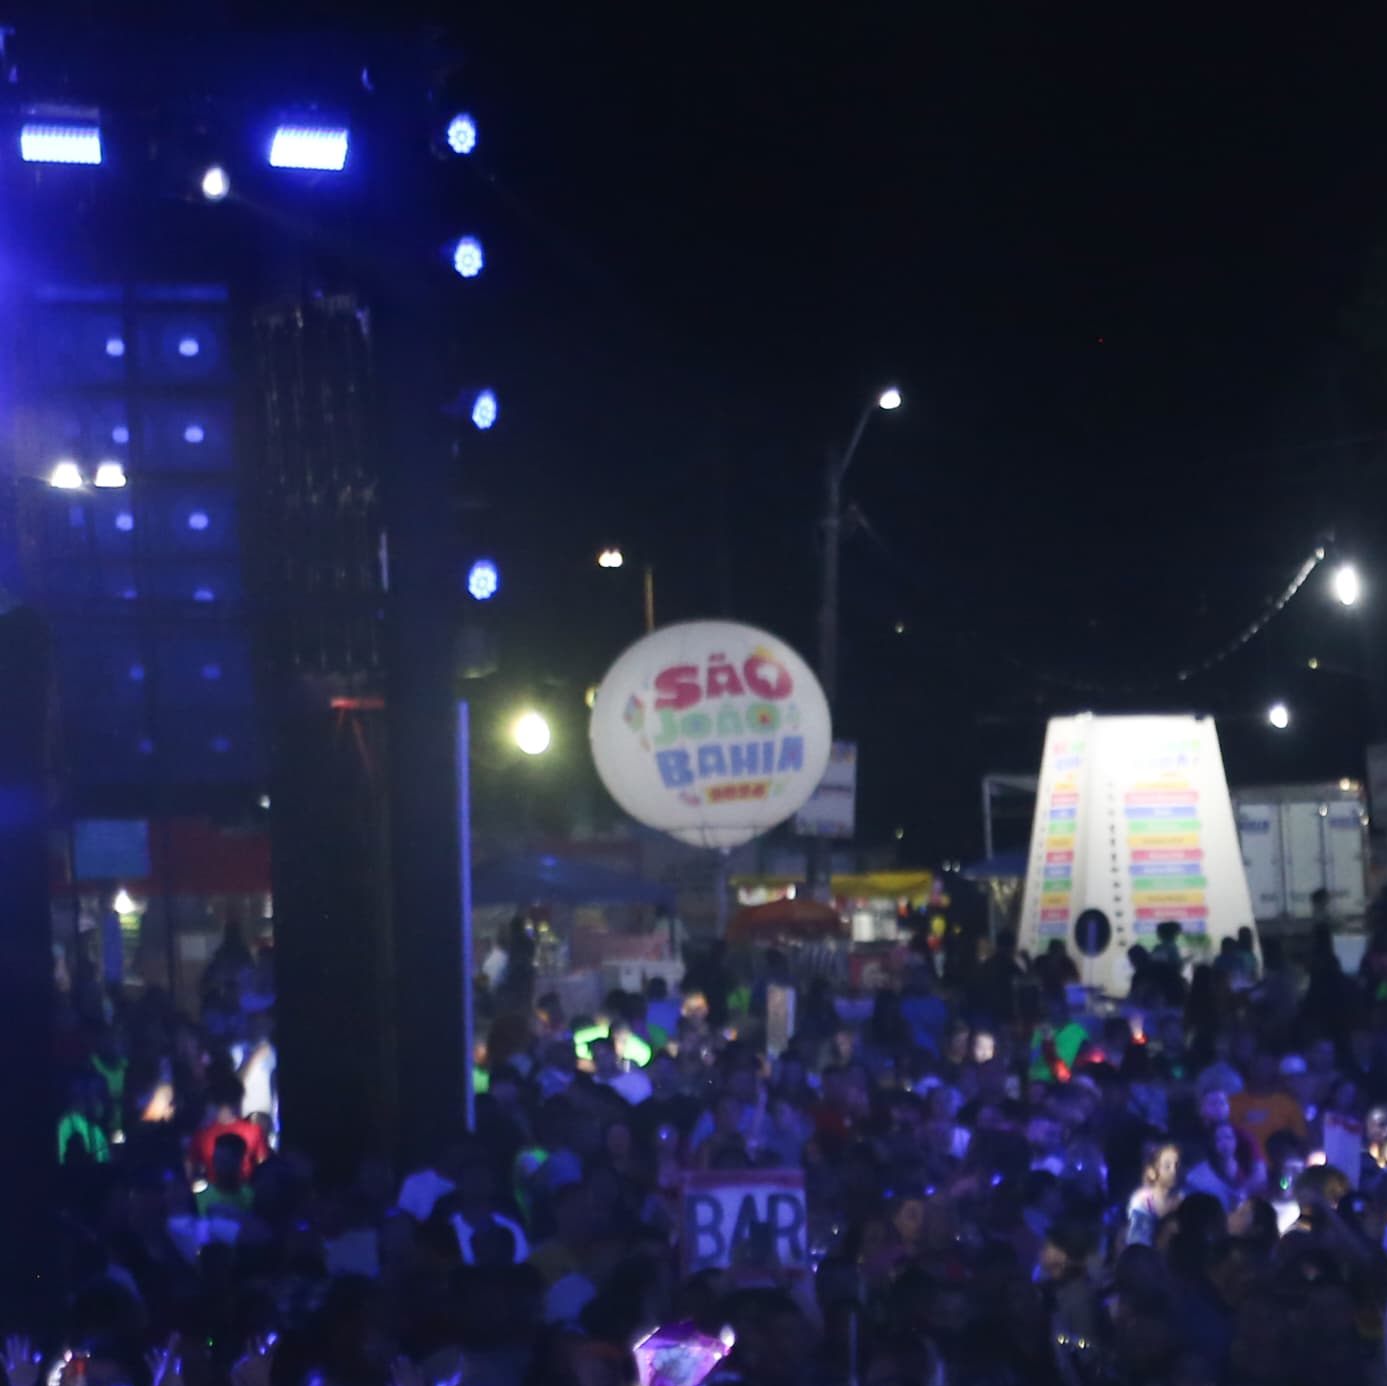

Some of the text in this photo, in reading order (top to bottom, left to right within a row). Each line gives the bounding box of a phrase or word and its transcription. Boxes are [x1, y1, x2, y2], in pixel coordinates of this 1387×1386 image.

[654, 652, 794, 711] SÃO
[656, 736, 805, 790] BAHIA
[687, 1193, 806, 1268] BAR
